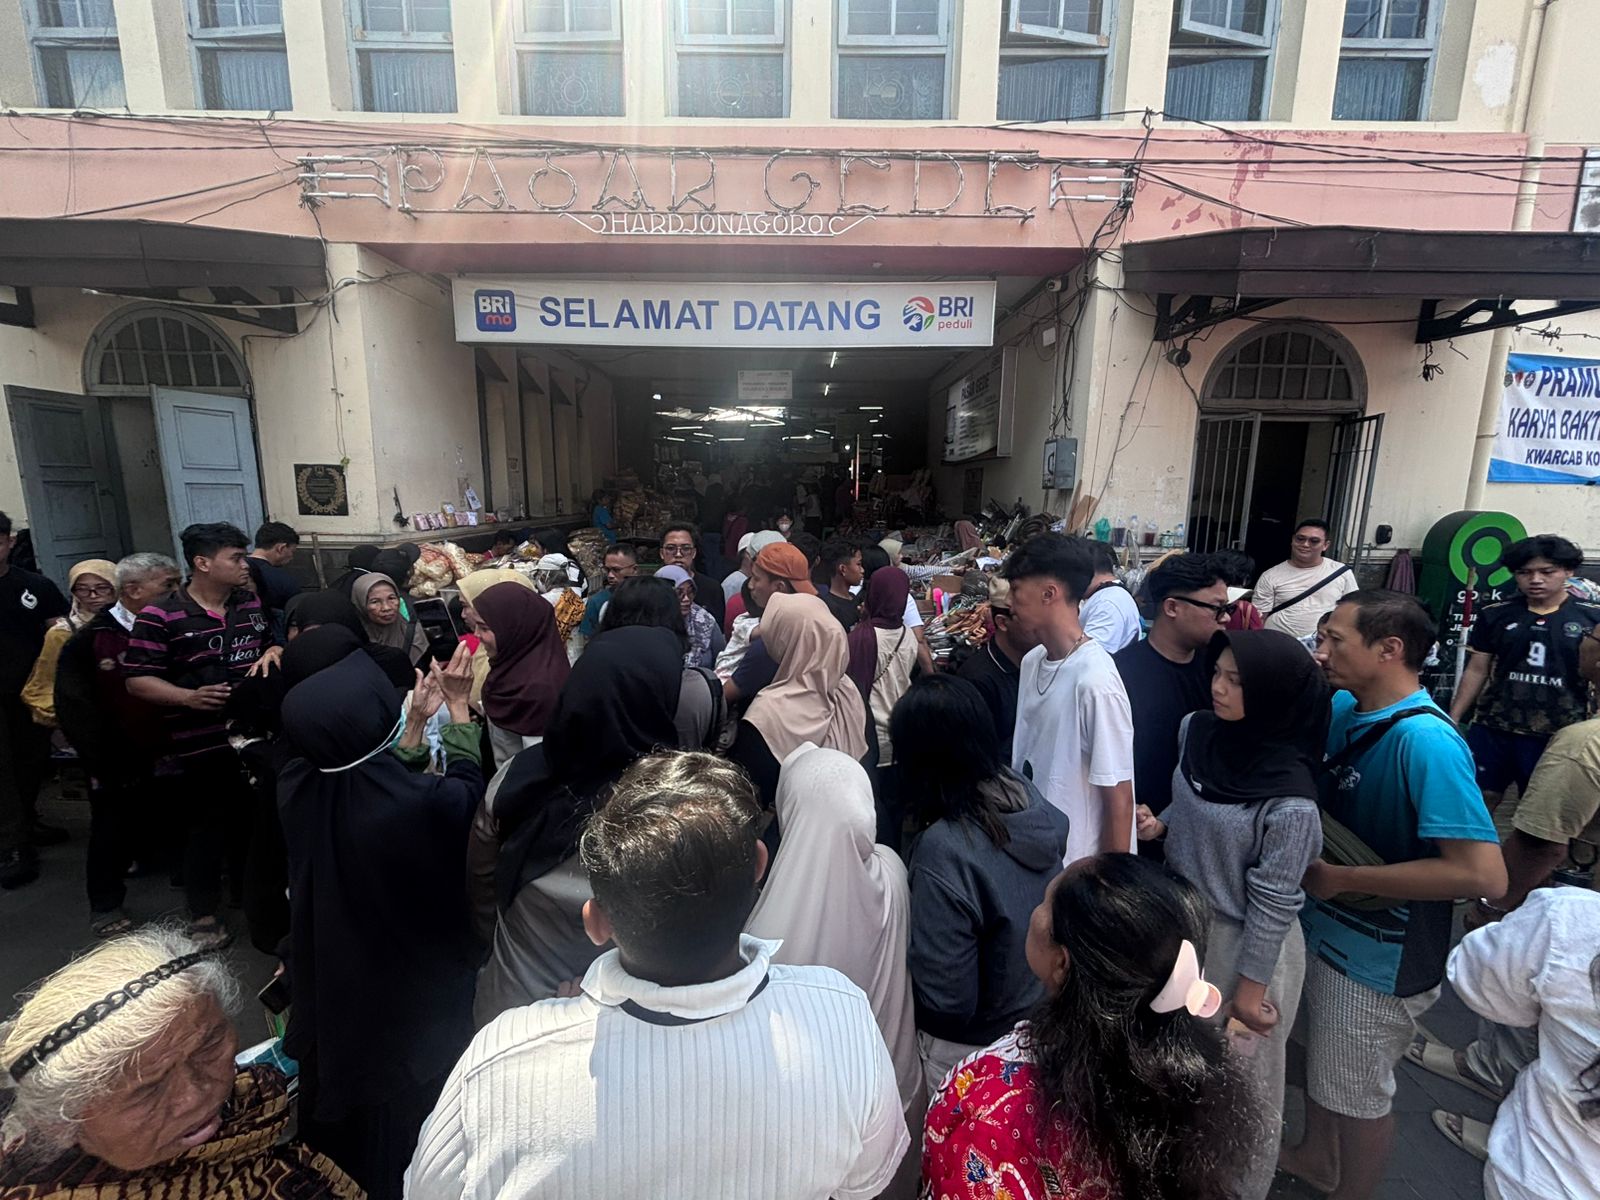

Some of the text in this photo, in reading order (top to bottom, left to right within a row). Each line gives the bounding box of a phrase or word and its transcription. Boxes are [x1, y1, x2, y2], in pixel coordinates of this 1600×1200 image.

[397, 146, 1039, 215] PASAR GEDE
[611, 213, 823, 234] HARDJONAGORO
[478, 295, 511, 314] BRI
[539, 296, 881, 331] SELAMAT DATANG
[938, 296, 974, 317] BRI
[485, 313, 512, 326] mo
[938, 319, 972, 331] peduli
[1507, 407, 1556, 439] KARYA
[1525, 448, 1582, 466] KWARCAB
[1526, 641, 1547, 667] 9
